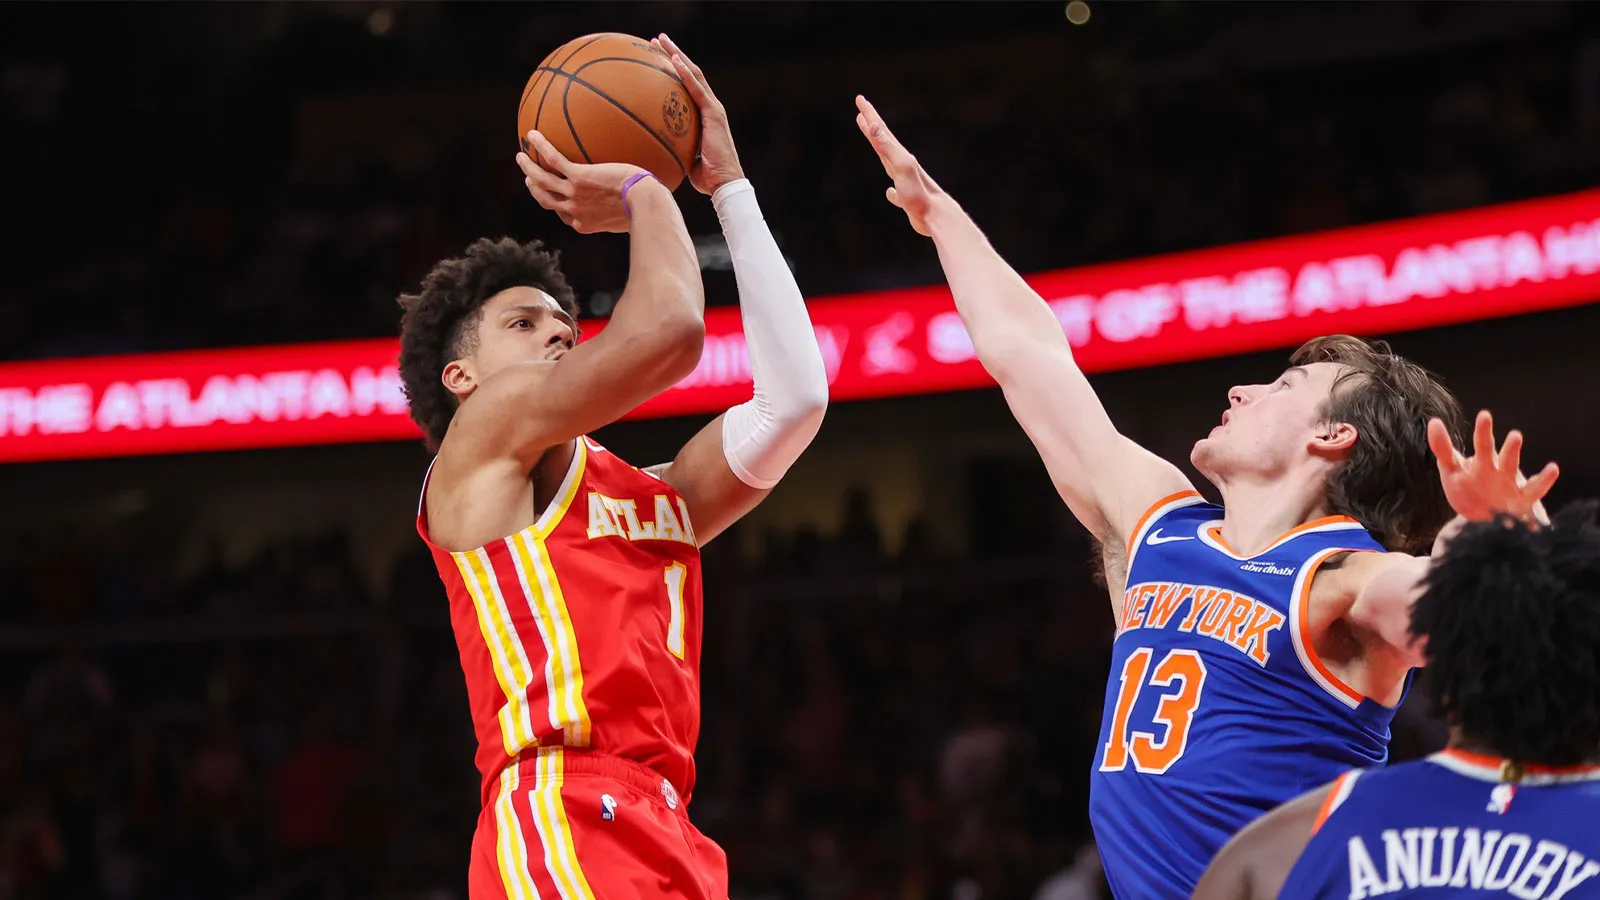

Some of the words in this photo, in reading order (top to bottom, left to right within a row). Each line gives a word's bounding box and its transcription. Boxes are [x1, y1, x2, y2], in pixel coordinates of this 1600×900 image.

[1095, 283, 1178, 342] OF
[1179, 266, 1290, 331] THE
[1294, 231, 1544, 317] ATLANTA
[97, 369, 350, 432] ATLANTA
[664, 560, 687, 661] 1
[1117, 581, 1193, 638] NEW
[1178, 583, 1287, 668] YORK
[1099, 647, 1208, 775] 13
[1348, 827, 1600, 900] ANUNOBY
